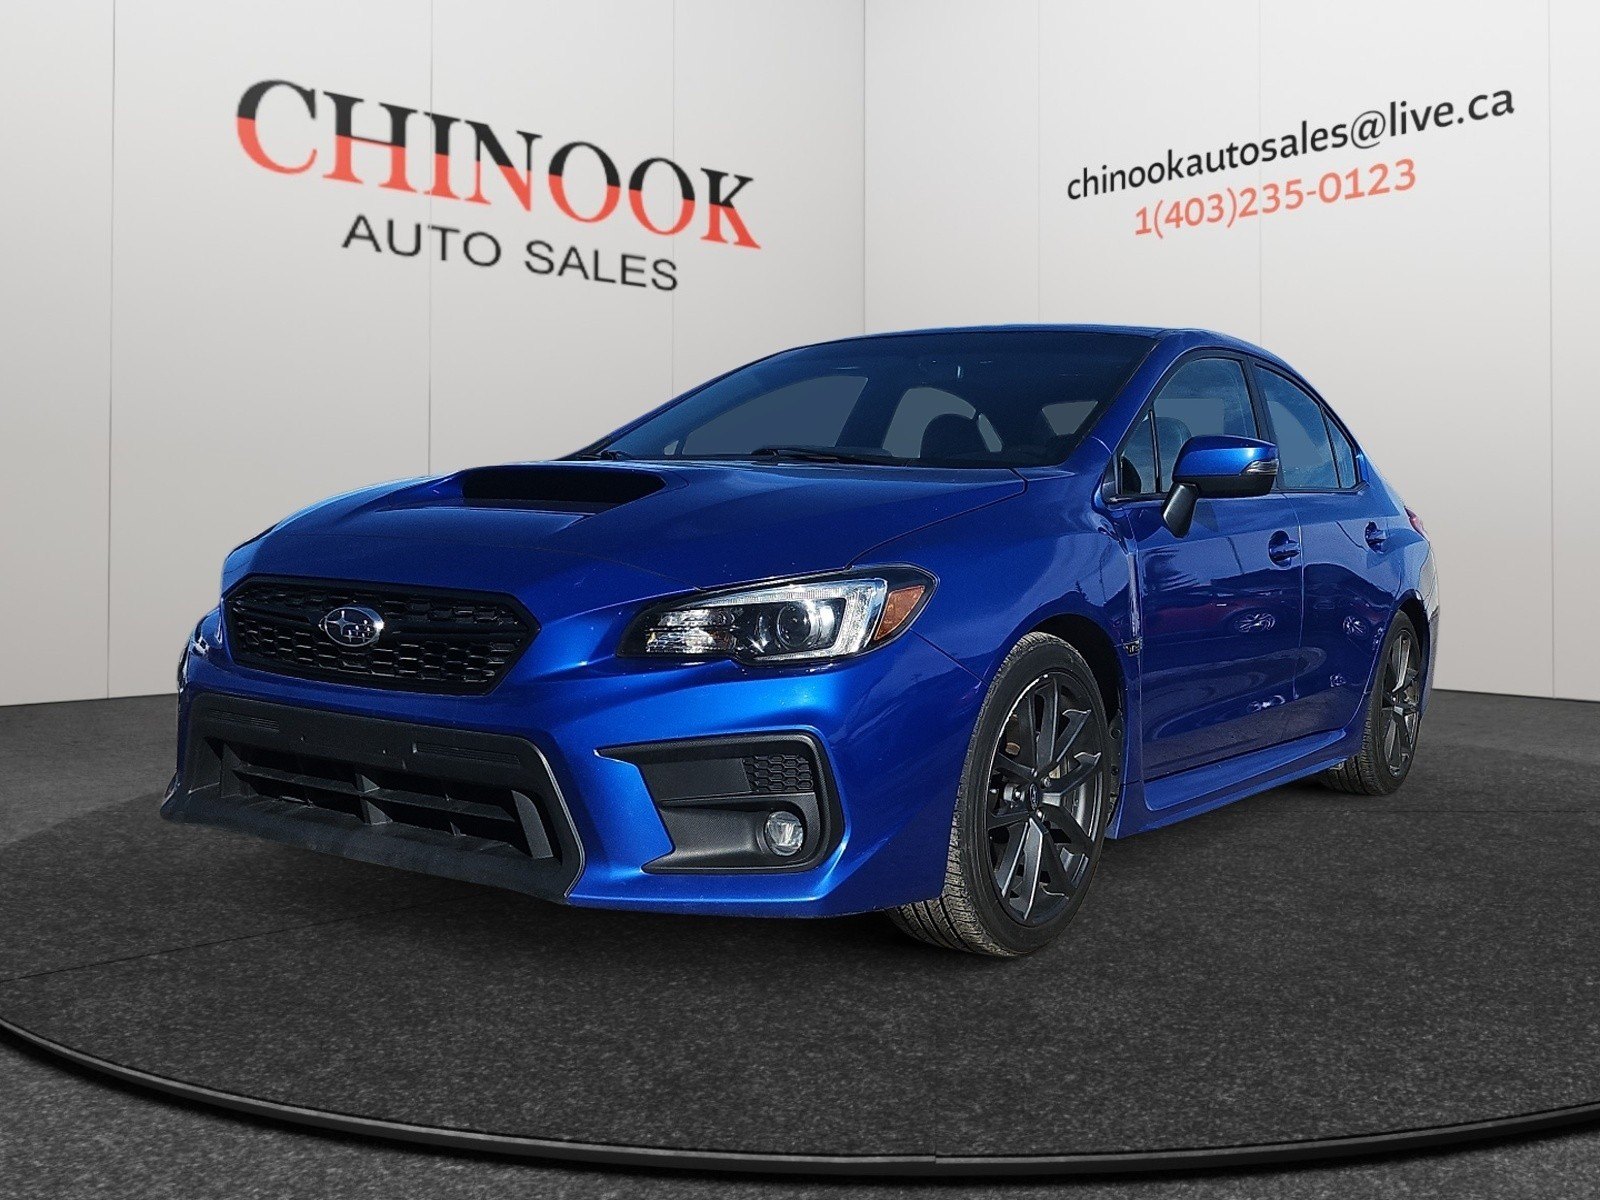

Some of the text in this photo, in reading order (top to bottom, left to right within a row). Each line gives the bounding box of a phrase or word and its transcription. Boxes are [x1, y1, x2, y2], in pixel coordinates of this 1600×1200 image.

[236, 79, 761, 249] CHINOOK
[1066, 89, 1516, 200] chinookautosales@live.ca
[1134, 158, 1417, 238] 1(403)235-0123
[342, 213, 679, 291] AUTO SALES
